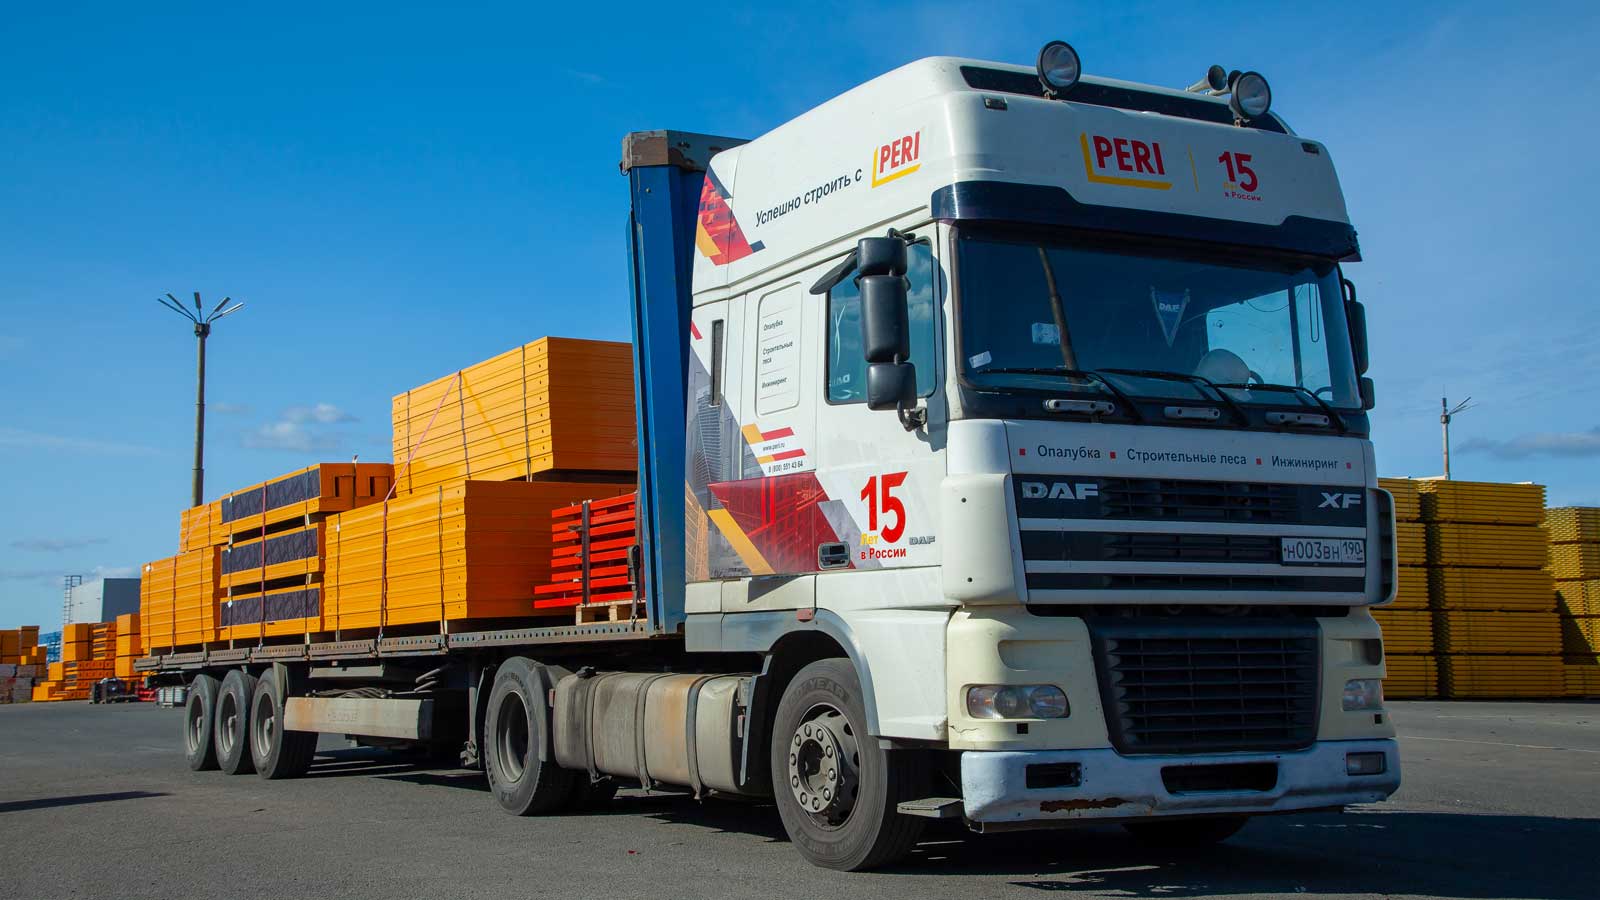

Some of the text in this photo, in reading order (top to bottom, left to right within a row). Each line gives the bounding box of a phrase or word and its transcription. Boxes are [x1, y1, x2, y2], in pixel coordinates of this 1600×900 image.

[880, 131, 920, 174] PERI
[1093, 135, 1165, 175] PERI
[1218, 151, 1258, 192] 15
[756, 168, 862, 227] Успешно строить с
[1231, 191, 1262, 201] России
[1037, 444, 1101, 461] Опалубка
[1127, 448, 1247, 465] Строительные леса
[1272, 455, 1338, 471] Инжиниринг
[1022, 481, 1098, 500] DAF
[861, 471, 908, 543] 15
[1318, 492, 1361, 509] XF
[909, 536, 935, 545] DAF
[1342, 541, 1360, 555] 190
[861, 547, 906, 560] в России
